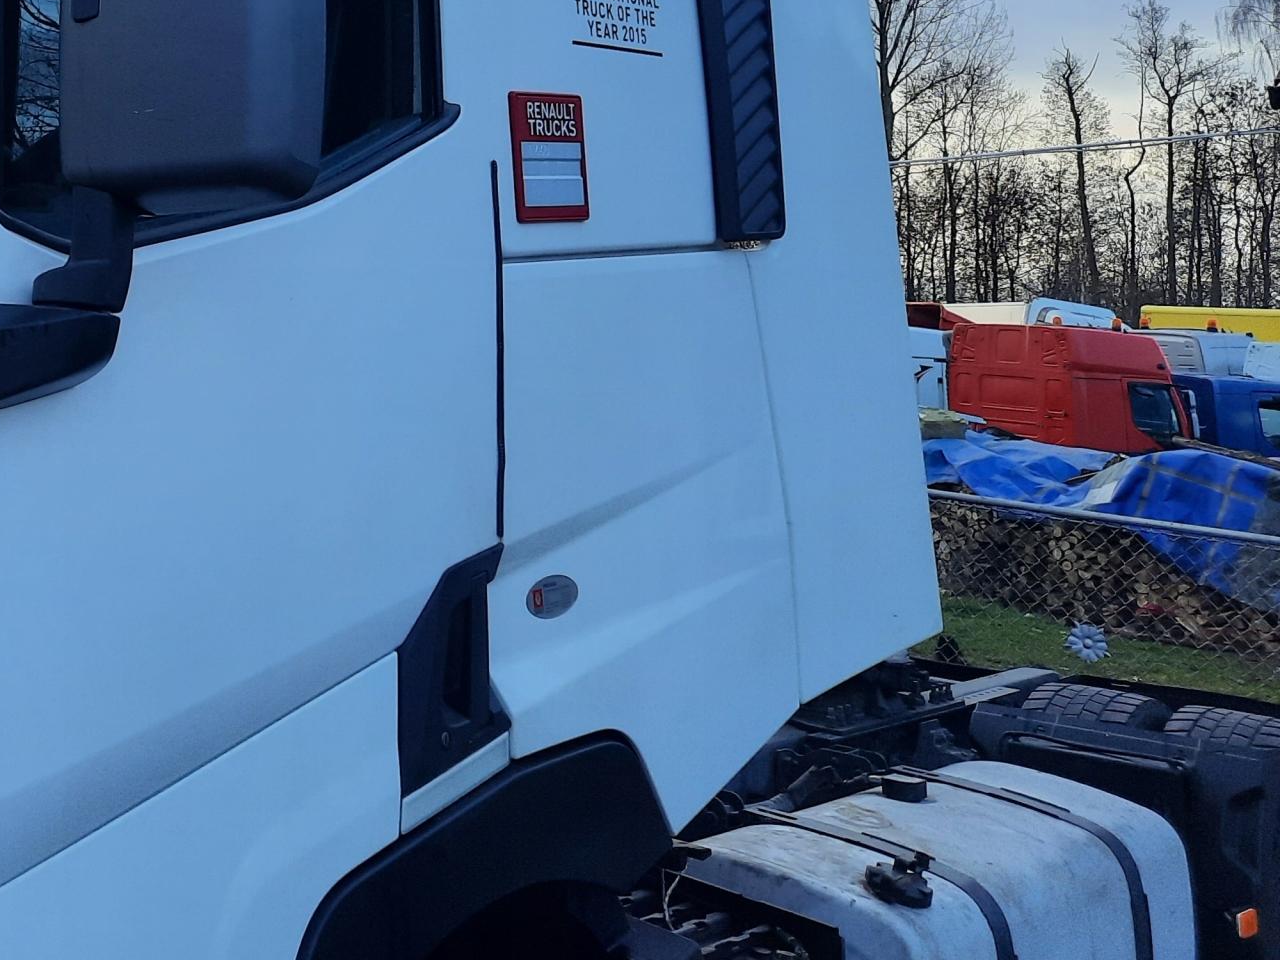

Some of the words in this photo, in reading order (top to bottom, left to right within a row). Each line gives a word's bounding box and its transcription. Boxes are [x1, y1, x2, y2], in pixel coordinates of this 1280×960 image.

[617, 5, 631, 23] OF
[634, 8, 656, 27] THE
[587, 19, 619, 41] YEAR
[622, 25, 647, 45] 2015
[526, 101, 575, 120] RENAULT
[528, 119, 577, 137] TRUCKS
